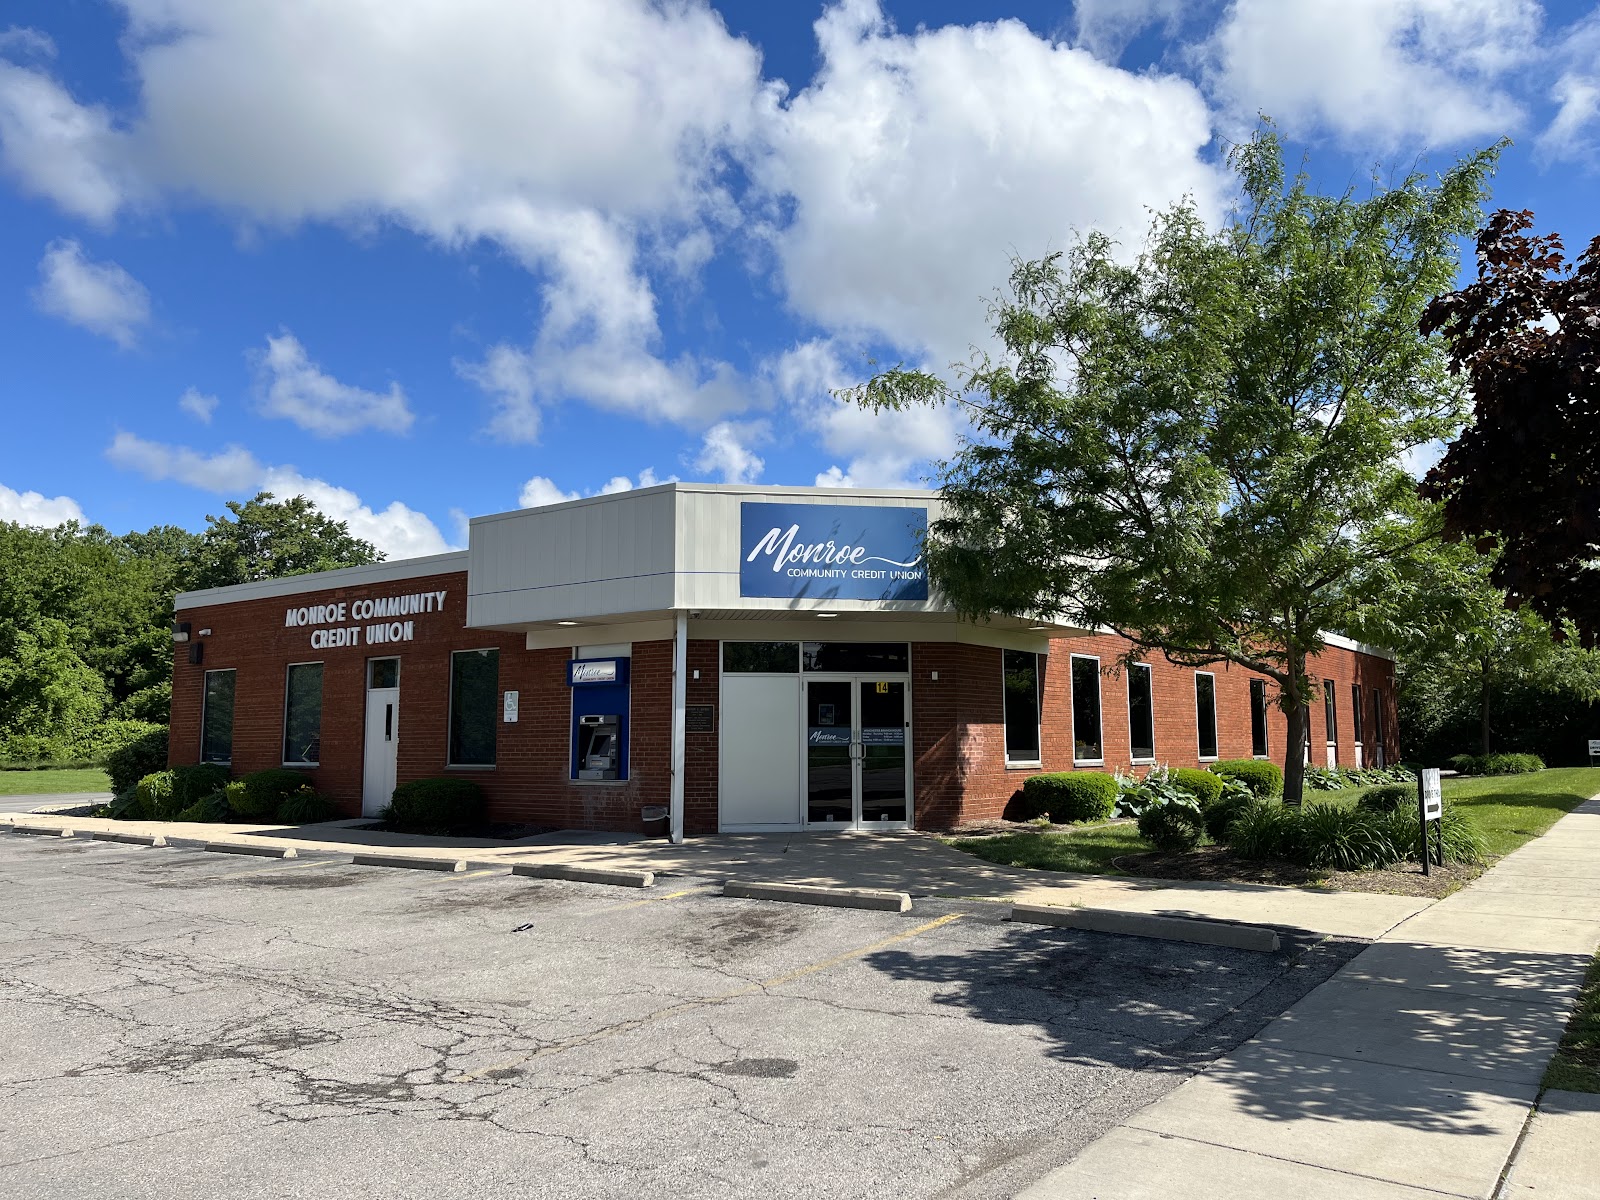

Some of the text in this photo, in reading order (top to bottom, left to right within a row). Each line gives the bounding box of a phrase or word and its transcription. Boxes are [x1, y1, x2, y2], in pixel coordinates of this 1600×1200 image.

[747, 523, 922, 573] Monroe
[787, 568, 922, 580] COMMUNITY CREDIT UNION
[285, 591, 447, 627] MONROE COMMUNITY
[310, 621, 415, 649] CREDIT UNION
[877, 682, 888, 692] 14
